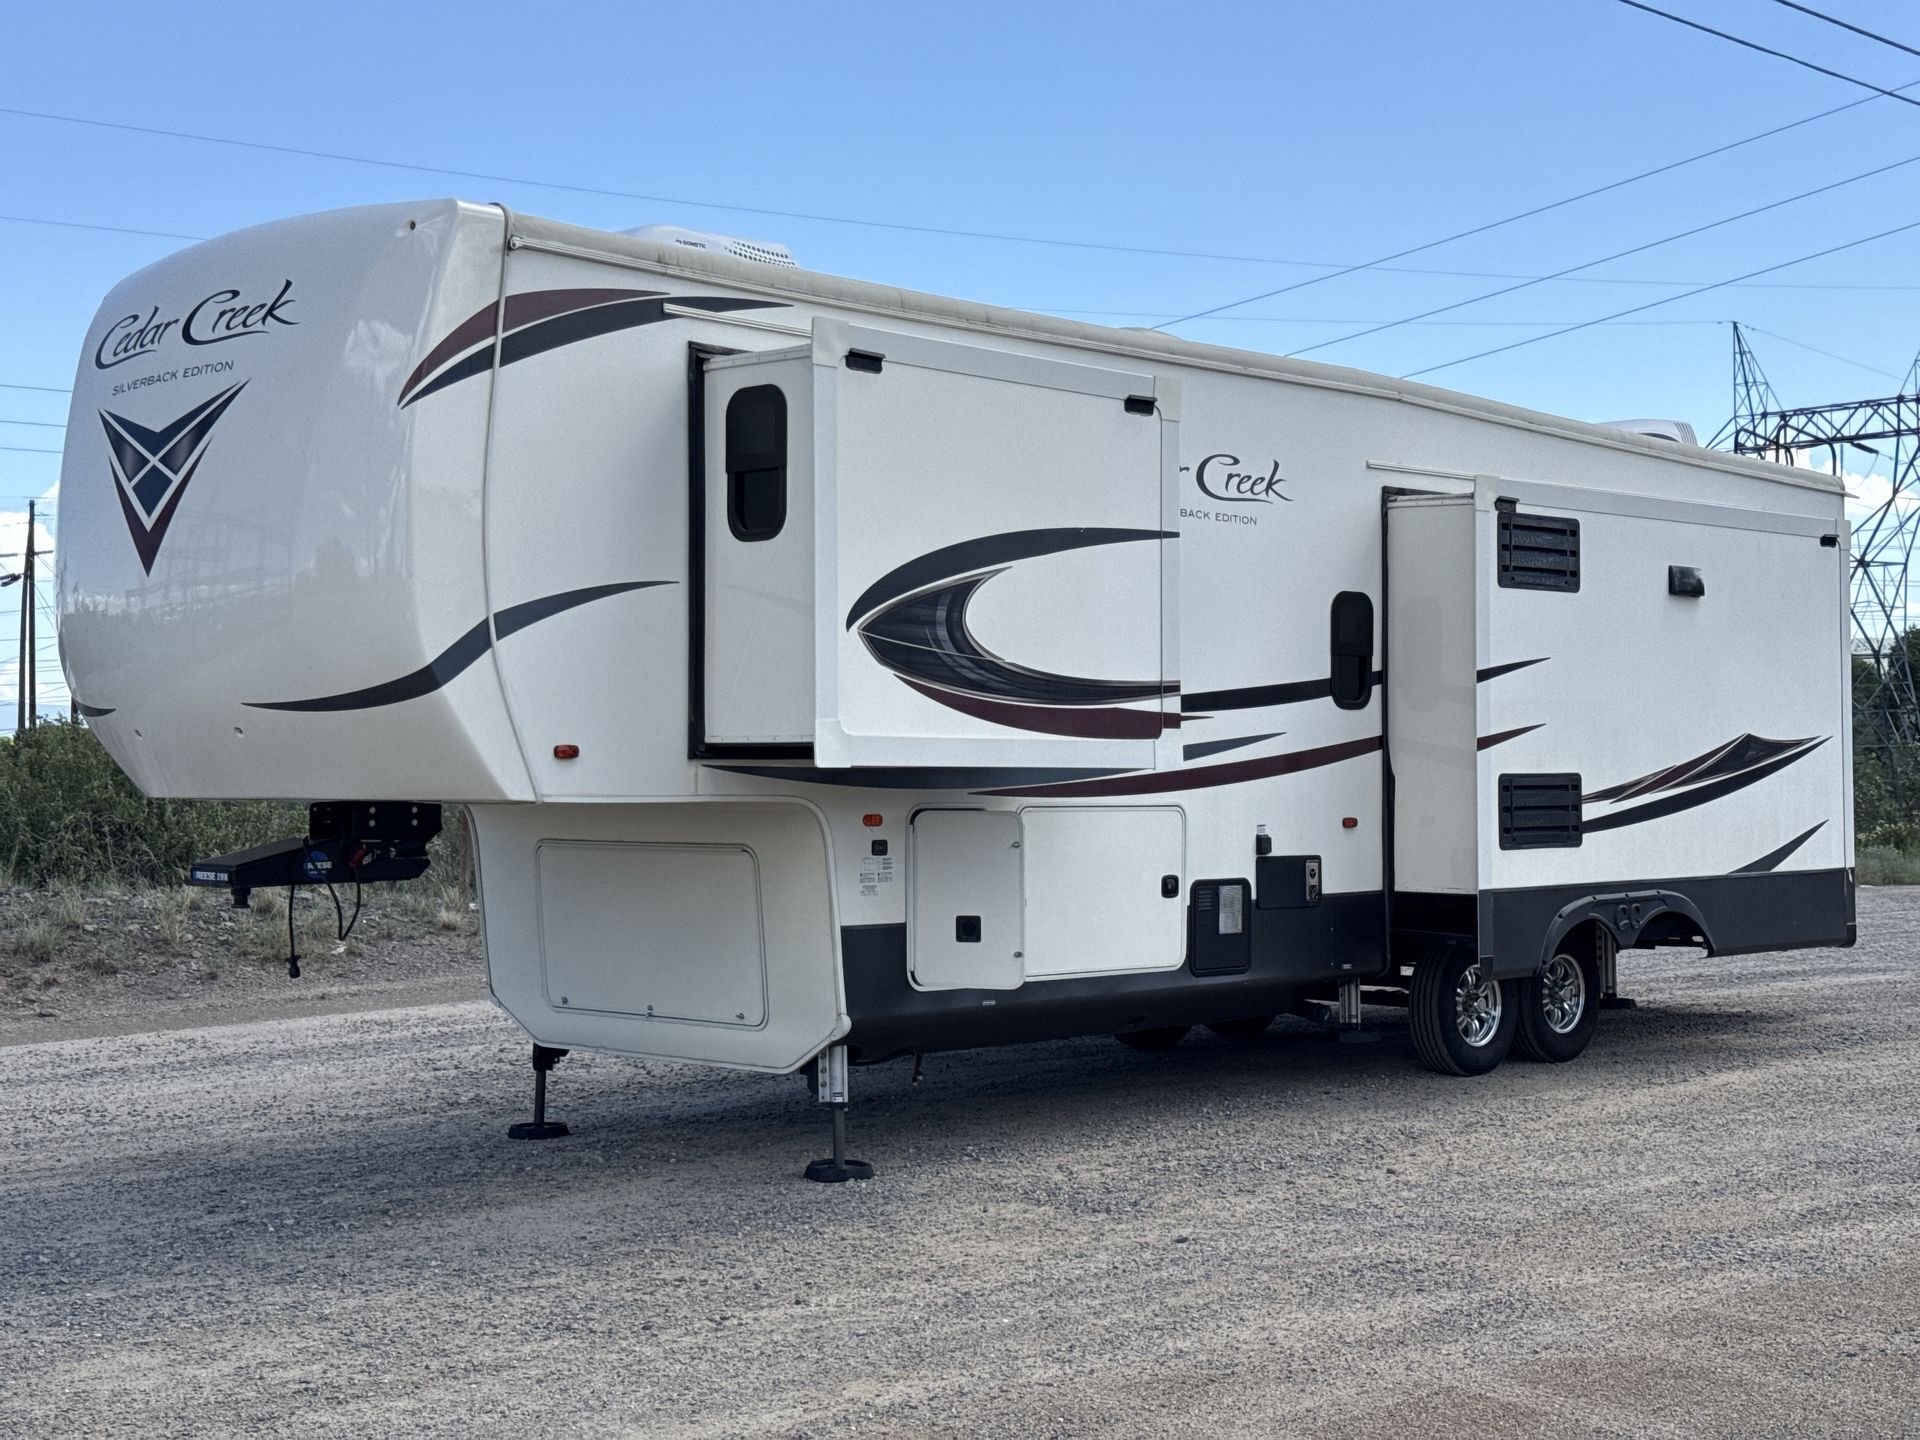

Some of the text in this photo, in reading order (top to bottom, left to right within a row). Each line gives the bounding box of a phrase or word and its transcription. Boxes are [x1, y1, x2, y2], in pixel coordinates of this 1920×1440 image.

[95, 278, 300, 370] Cedar Creek
[111, 360, 234, 396] SILVERBACK EDITION
[1196, 453, 1294, 505] Creek
[1215, 512, 1258, 526] EDITION
[195, 871, 216, 880] REESE
